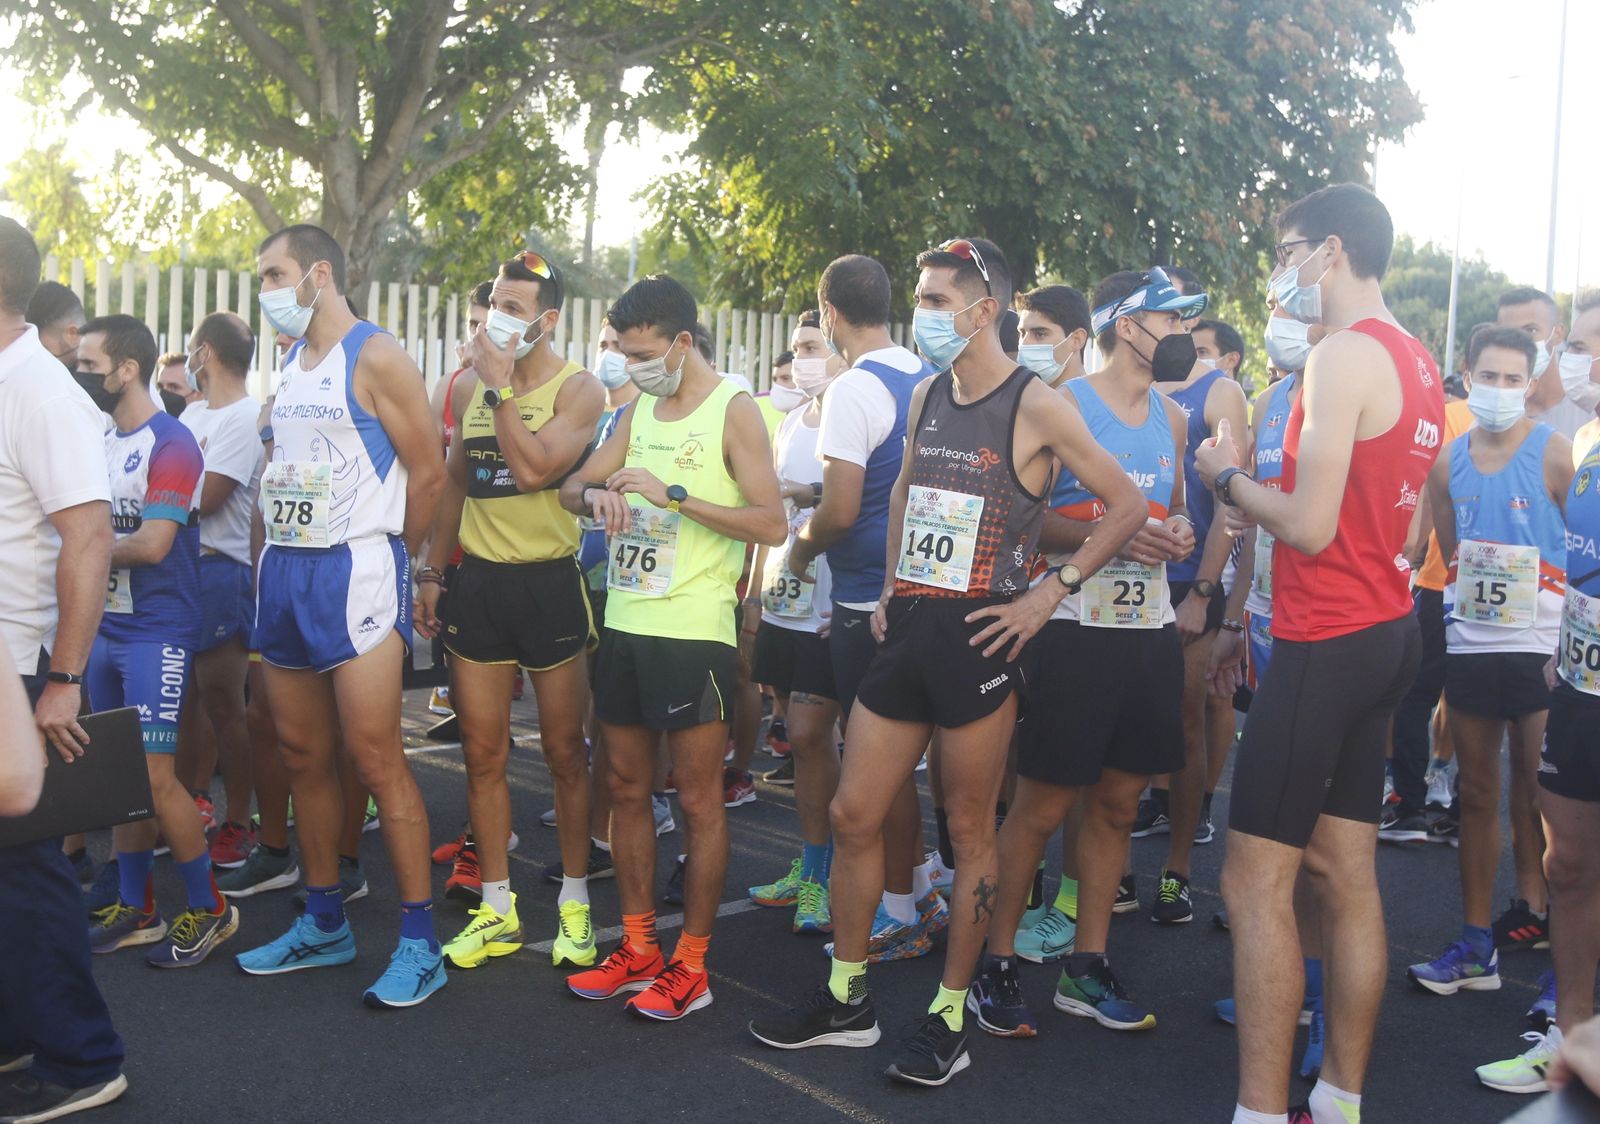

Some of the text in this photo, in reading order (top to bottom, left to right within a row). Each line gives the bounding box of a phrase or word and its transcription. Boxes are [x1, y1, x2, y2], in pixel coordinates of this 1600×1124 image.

[292, 403, 344, 420] ATLETISMO
[1257, 447, 1283, 465] ene
[111, 516, 135, 529] ARIO
[273, 499, 314, 526] 278
[615, 543, 657, 573] 476
[906, 529, 954, 564] 140
[109, 571, 118, 593] 5
[1112, 580, 1146, 607] 23
[1474, 580, 1507, 606] 15
[158, 643, 187, 722] ALCONC
[979, 673, 1009, 695] Joma
